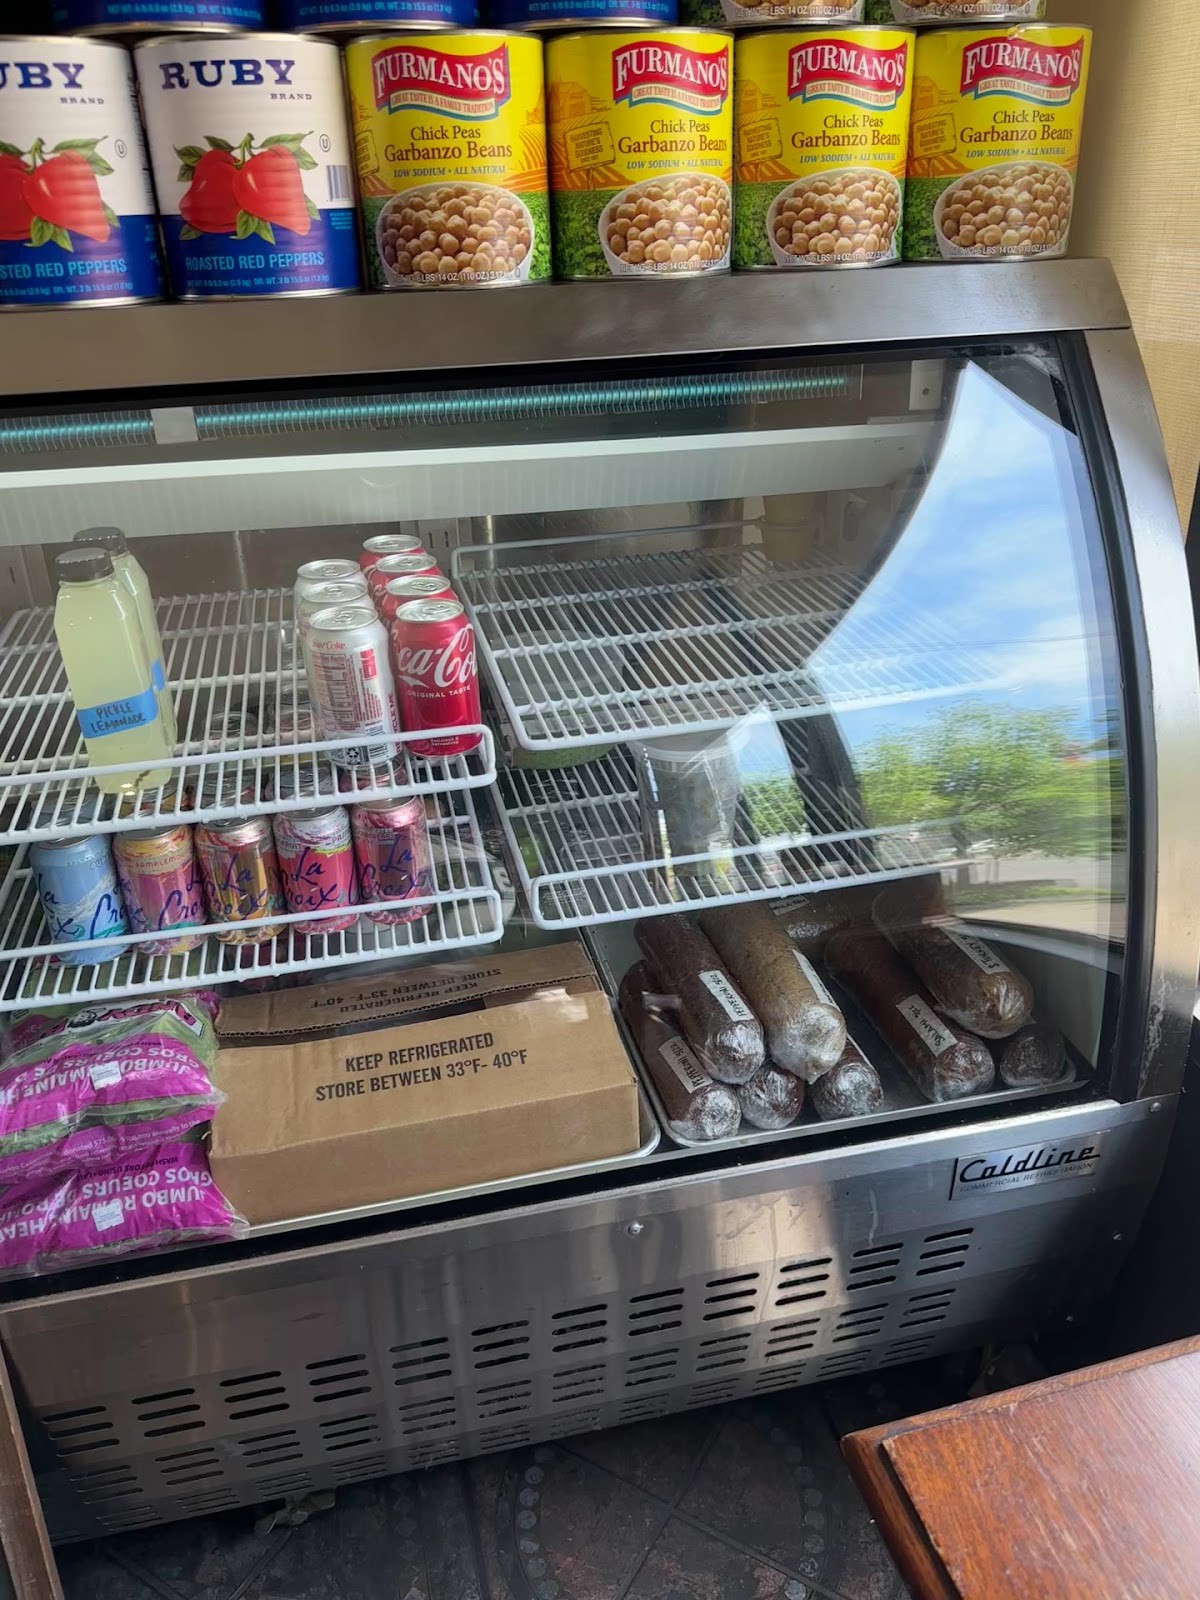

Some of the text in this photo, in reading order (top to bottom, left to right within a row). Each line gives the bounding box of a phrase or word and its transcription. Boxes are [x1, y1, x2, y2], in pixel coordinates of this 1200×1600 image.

[788, 6, 796, 14] 14
[616, 47, 727, 92] FURMANO'S
[791, 45, 904, 89] FURMANO'S
[963, 42, 1080, 85] FURMANO'S
[159, 59, 295, 90] RUBY
[374, 52, 505, 99] FURMANO'S
[60, 97, 104, 105] BRAND
[270, 93, 312, 101] BRAND
[650, 119, 710, 134] Chick Peas
[823, 114, 883, 129] Chick Peas
[993, 110, 1055, 124] Chick Peas
[411, 125, 480, 140] Chick Peas
[791, 129, 900, 149] Garbanzo Beans
[960, 125, 1073, 144] Garbanzo Beans
[384, 142, 462, 162] Garbanzo
[467, 141, 512, 158] Beans
[618, 134, 727, 154] Garbanzo Beans
[966, 150, 984, 158] LOW
[987, 149, 1019, 158] SODIUM
[627, 161, 645, 169] LOW
[648, 160, 679, 168] SODIUM
[686, 159, 698, 167] ALL
[800, 155, 817, 163] LOW
[820, 154, 852, 163] SODIUM
[394, 169, 411, 178] LOW
[413, 167, 446, 177] SODIUM
[453, 167, 468, 175] ALL
[35, 263, 64, 277] RED
[68, 258, 128, 276] PEPPERS
[186, 251, 325, 271] ROASTED RED PEPPERS
[438, 273, 446, 281] 14
[407, 684, 471, 698] ORIGINAL TASTE
[96, 702, 133, 719] PICKLE
[91, 712, 147, 734] LEMONADE
[292, 846, 325, 885] La
[457, 968, 501, 982] STORE
[393, 976, 456, 995] BETWEEN
[340, 982, 477, 1013] KEEP REFRIGERATED
[920, 1019, 946, 1047] SALAMI
[346, 1032, 494, 1072] KEEP REFRIGERATED
[120, 1058, 191, 1075] JUMBO
[316, 1080, 365, 1101] STORE
[371, 1066, 441, 1092] BETWEEN
[493, 1049, 528, 1069] 40°F
[82, 1170, 160, 1198] COEURS
[960, 1162, 1093, 1193] COMMERCIAL REFRIGERATION
